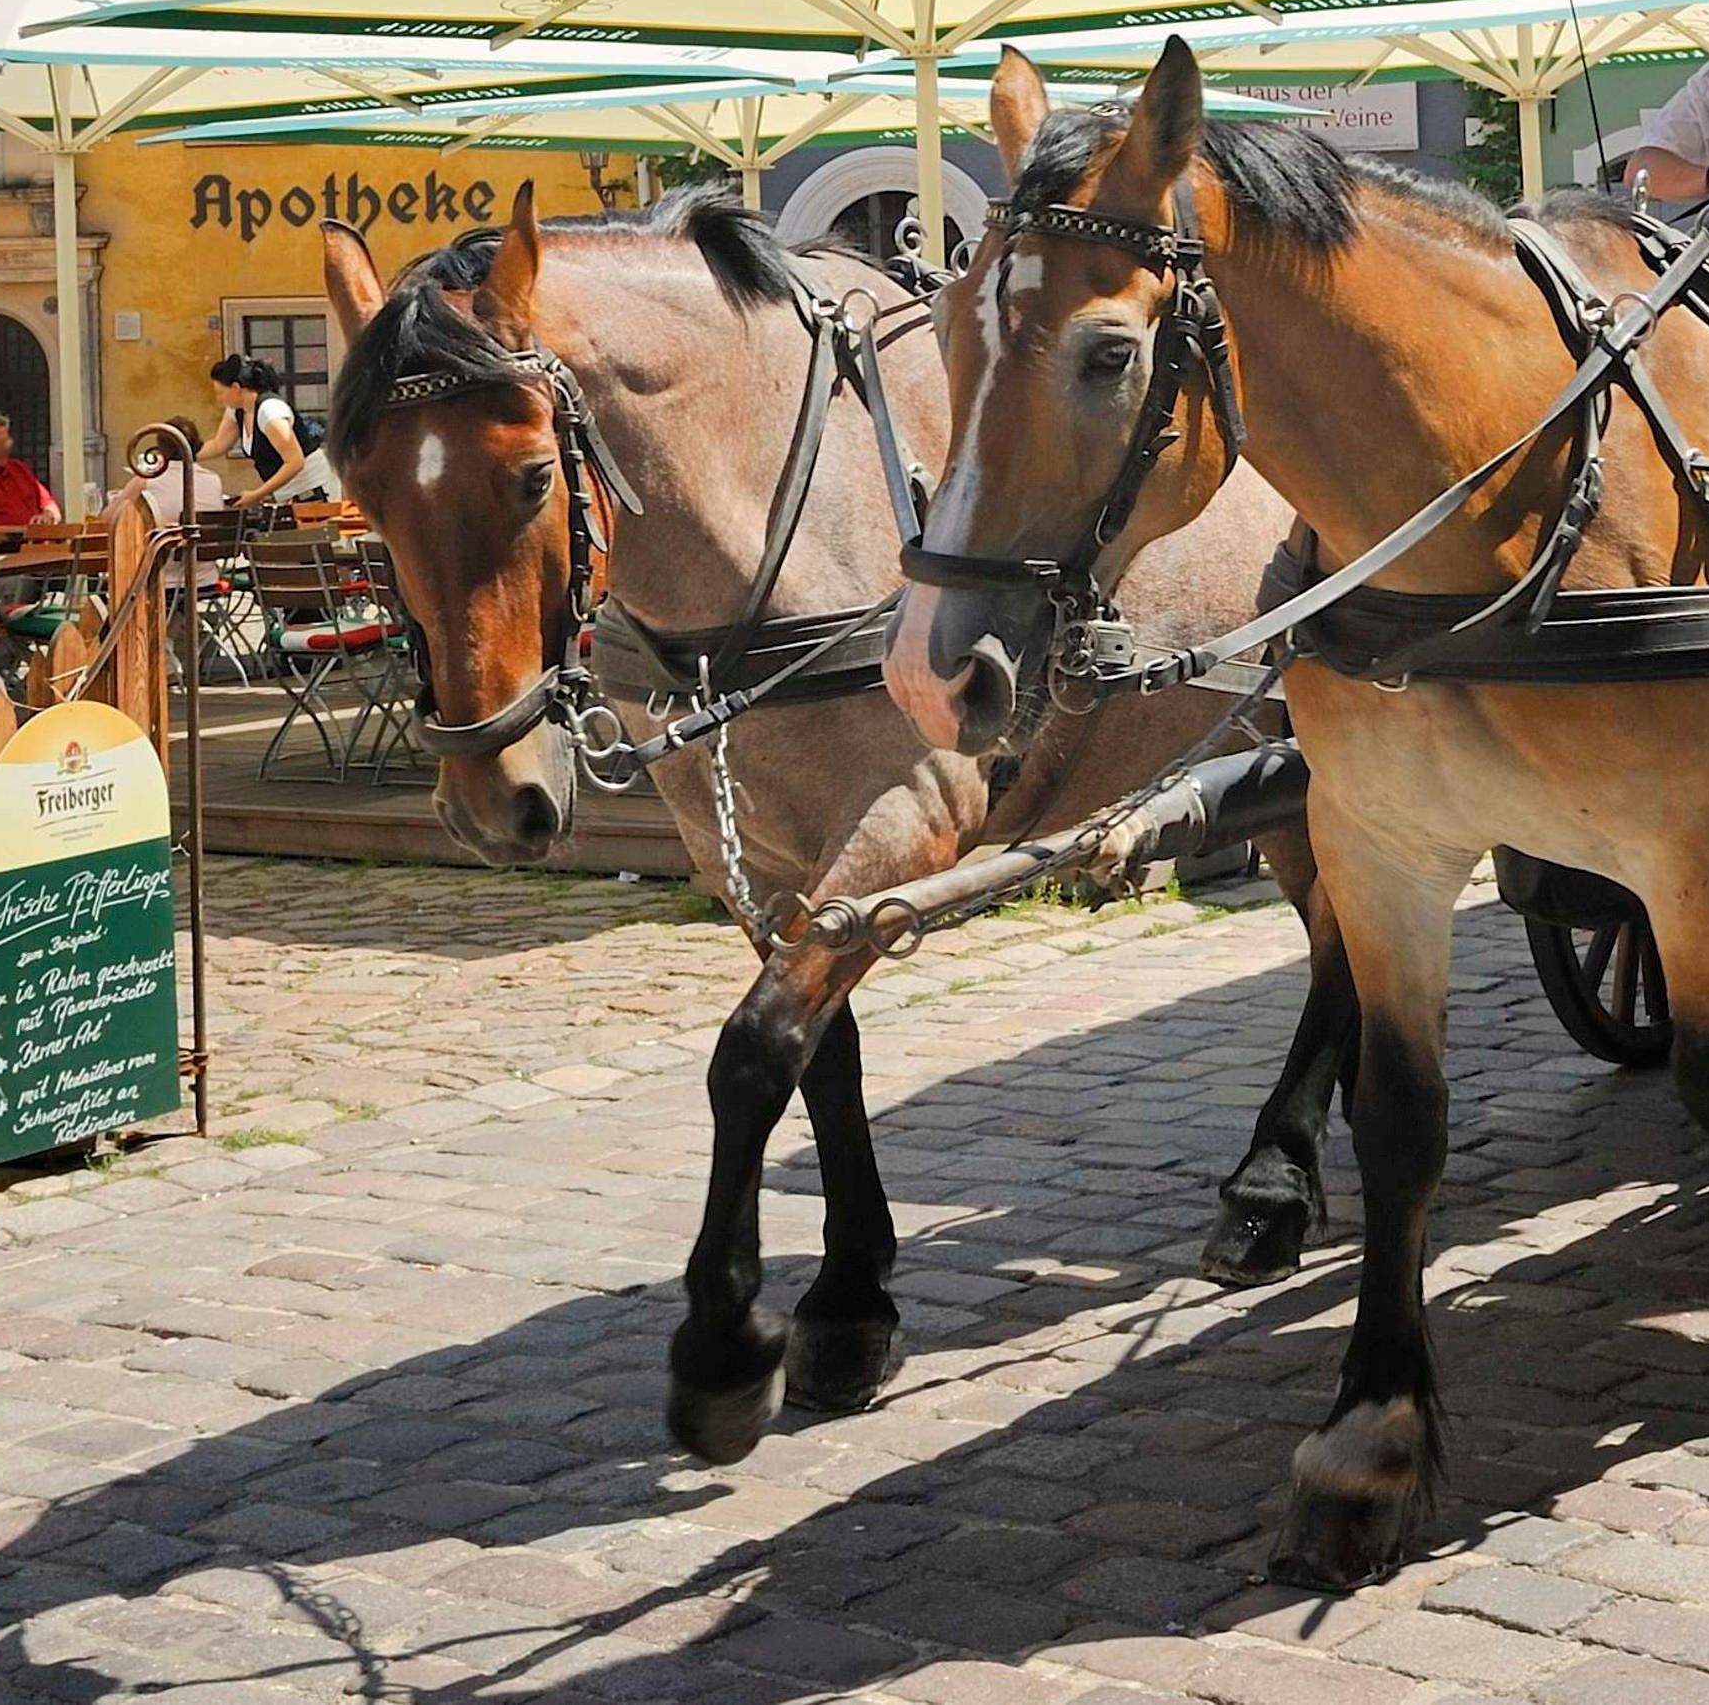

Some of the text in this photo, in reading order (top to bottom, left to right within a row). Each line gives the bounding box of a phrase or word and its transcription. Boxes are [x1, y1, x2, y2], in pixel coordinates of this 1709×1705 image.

[189, 169, 496, 243] Apotheke
[35, 783, 115, 817] Freiberger
[64, 864, 171, 929] Pfifferlinge
[40, 965, 91, 996] Rahm
[16, 1005, 44, 1035] mit
[17, 1074, 50, 1110] mit
